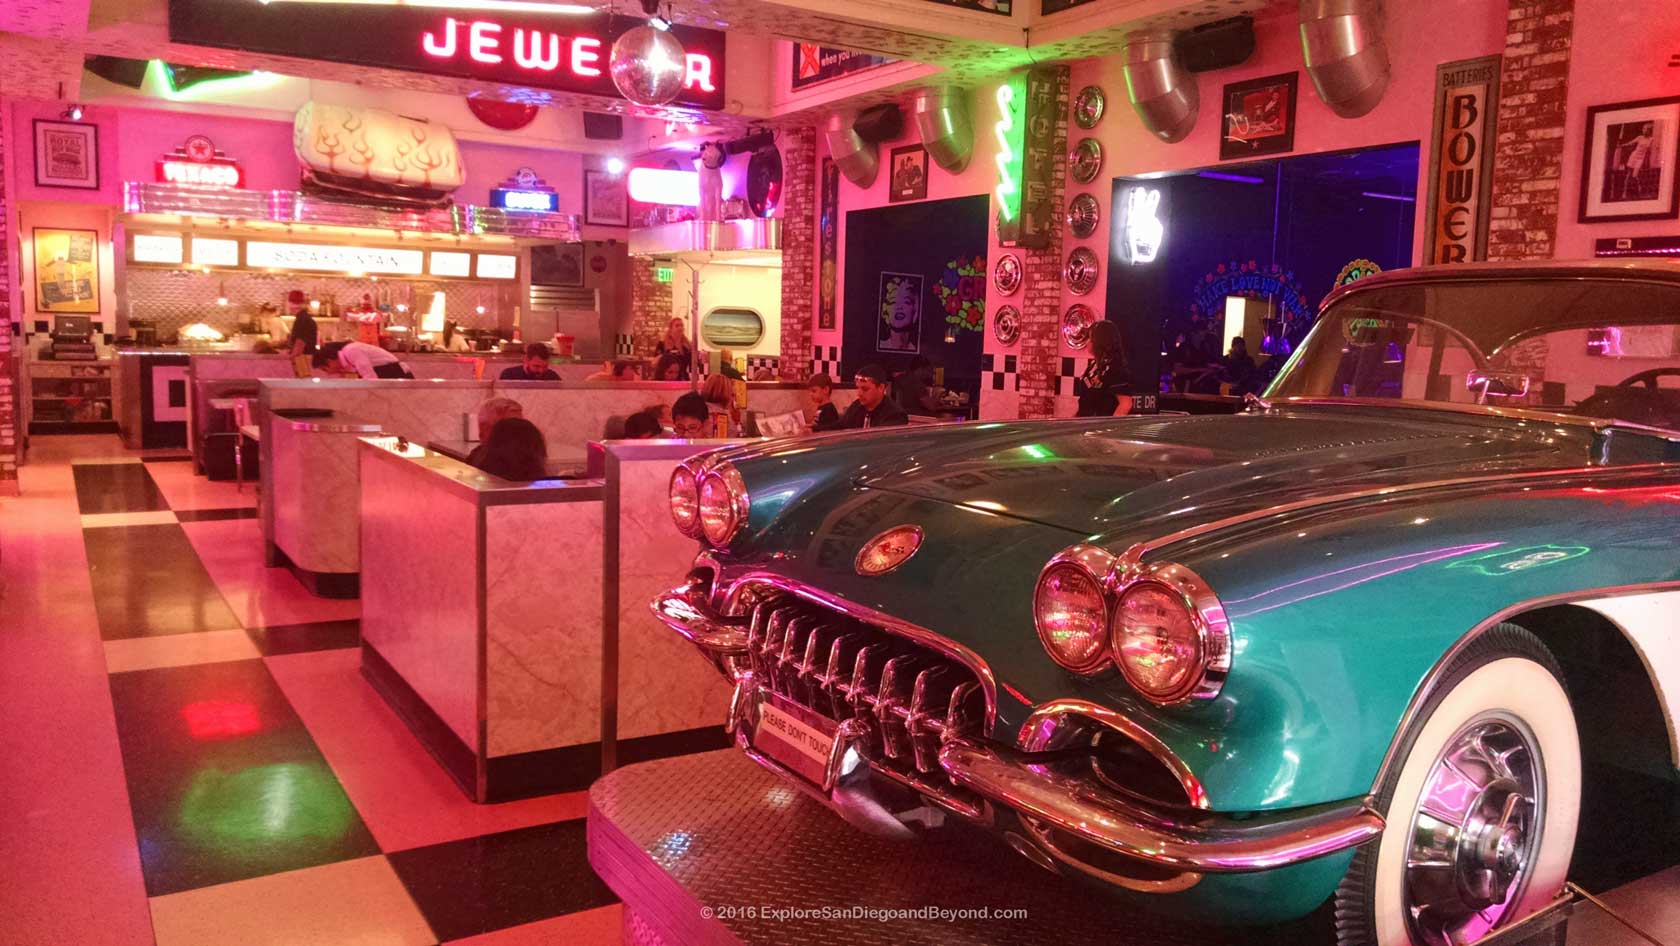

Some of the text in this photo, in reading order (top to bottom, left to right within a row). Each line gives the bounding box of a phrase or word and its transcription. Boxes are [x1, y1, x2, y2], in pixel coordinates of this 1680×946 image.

[422, 16, 716, 93] JEWER
[839, 50, 850, 66] you
[1443, 66, 1494, 87] BATTERIES
[1231, 276, 1260, 291] LOVE
[1144, 395, 1157, 409] DR
[763, 711, 787, 733] PLEASE
[788, 725, 807, 743] DON'T
